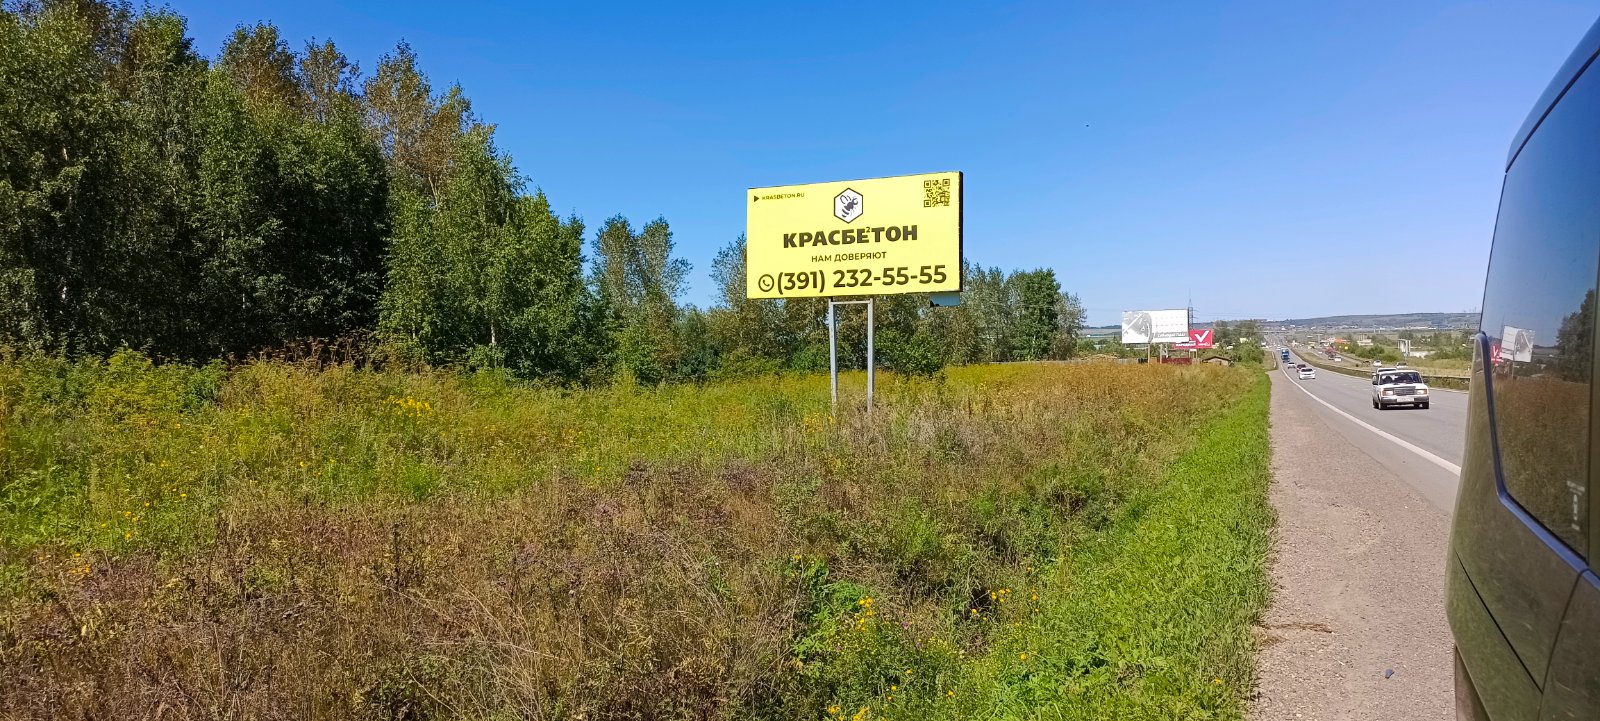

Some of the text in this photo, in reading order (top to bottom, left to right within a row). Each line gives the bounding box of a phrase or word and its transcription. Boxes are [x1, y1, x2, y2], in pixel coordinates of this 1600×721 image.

[811, 251, 887, 263] НАМ ДОВЕРЯЮТ
[777, 265, 947, 294] (391) 232-55-55
